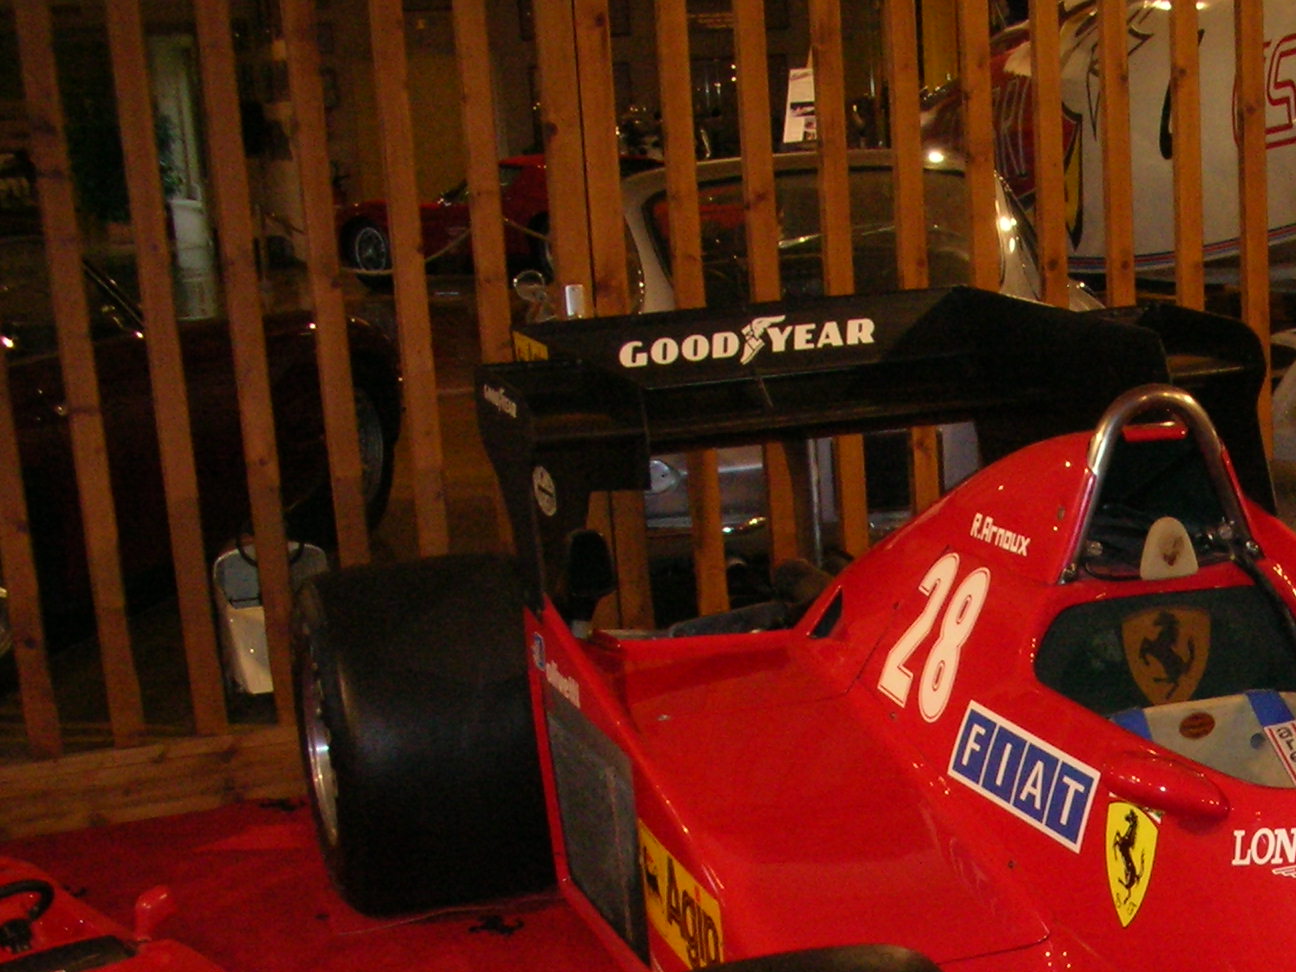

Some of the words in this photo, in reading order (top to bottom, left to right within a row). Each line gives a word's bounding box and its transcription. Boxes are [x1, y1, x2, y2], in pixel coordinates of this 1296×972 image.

[970, 512, 1031, 557] R.Arnoux
[877, 552, 991, 723] 28
[962, 723, 1085, 826] FIAT
